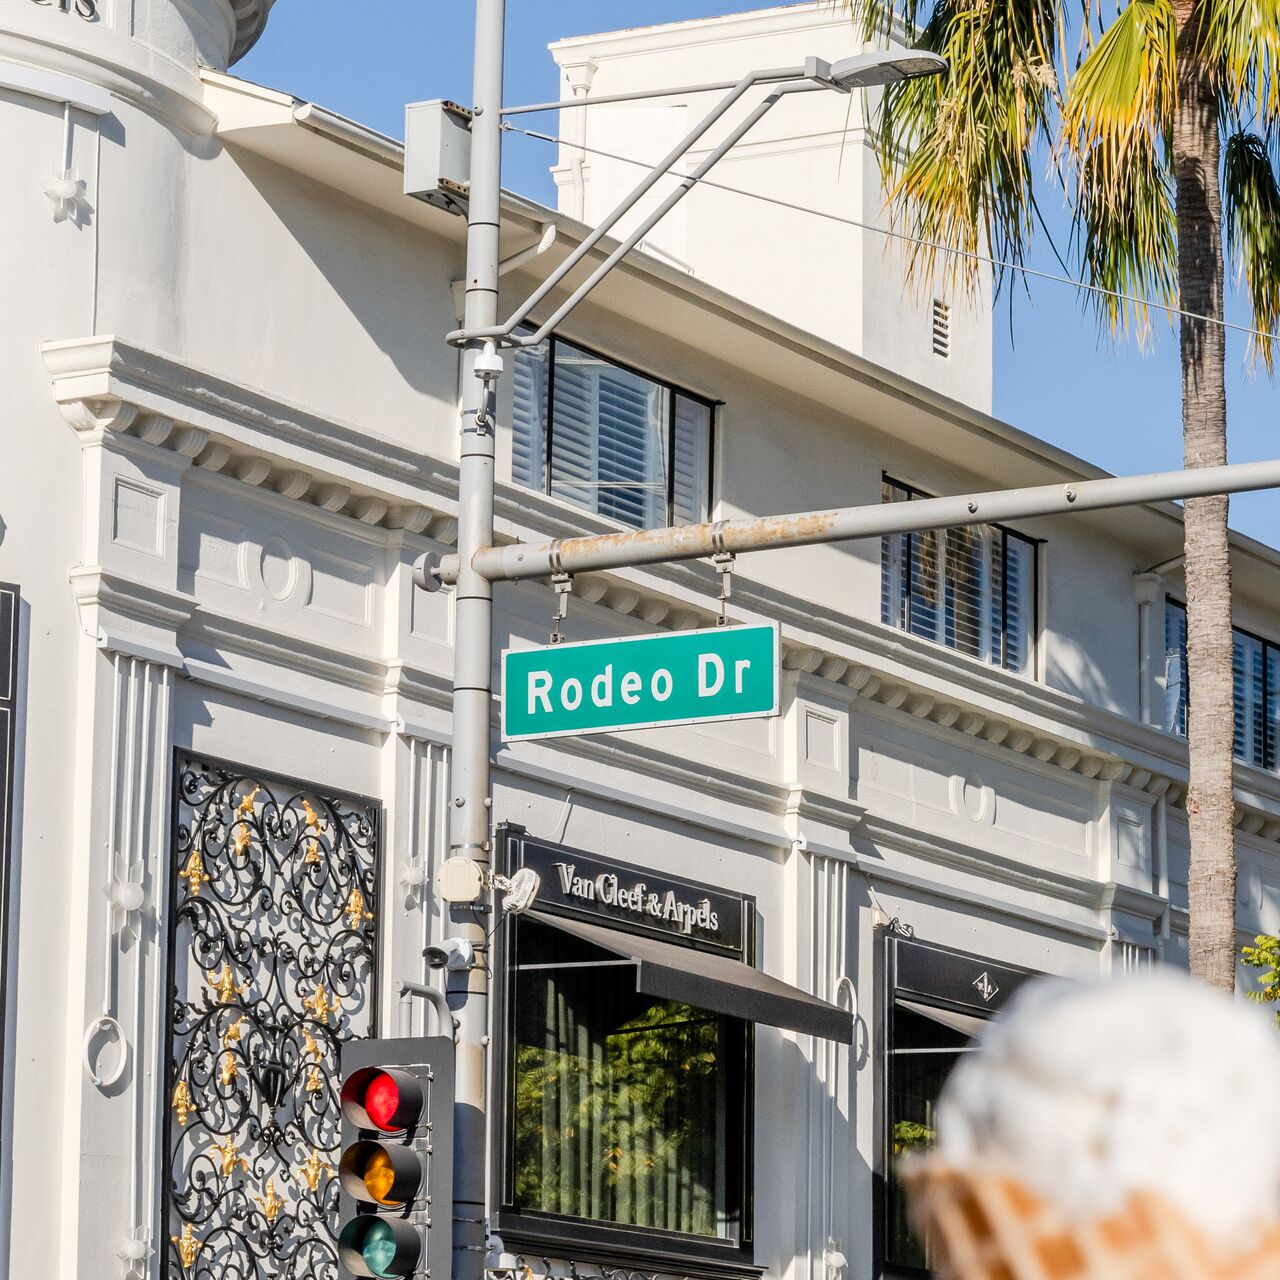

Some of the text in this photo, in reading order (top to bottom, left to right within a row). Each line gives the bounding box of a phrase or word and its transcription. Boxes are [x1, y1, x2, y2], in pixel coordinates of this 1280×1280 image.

[527, 653, 751, 714] Rodeo Dr
[552, 862, 719, 934] Van Cleef & Arpels
